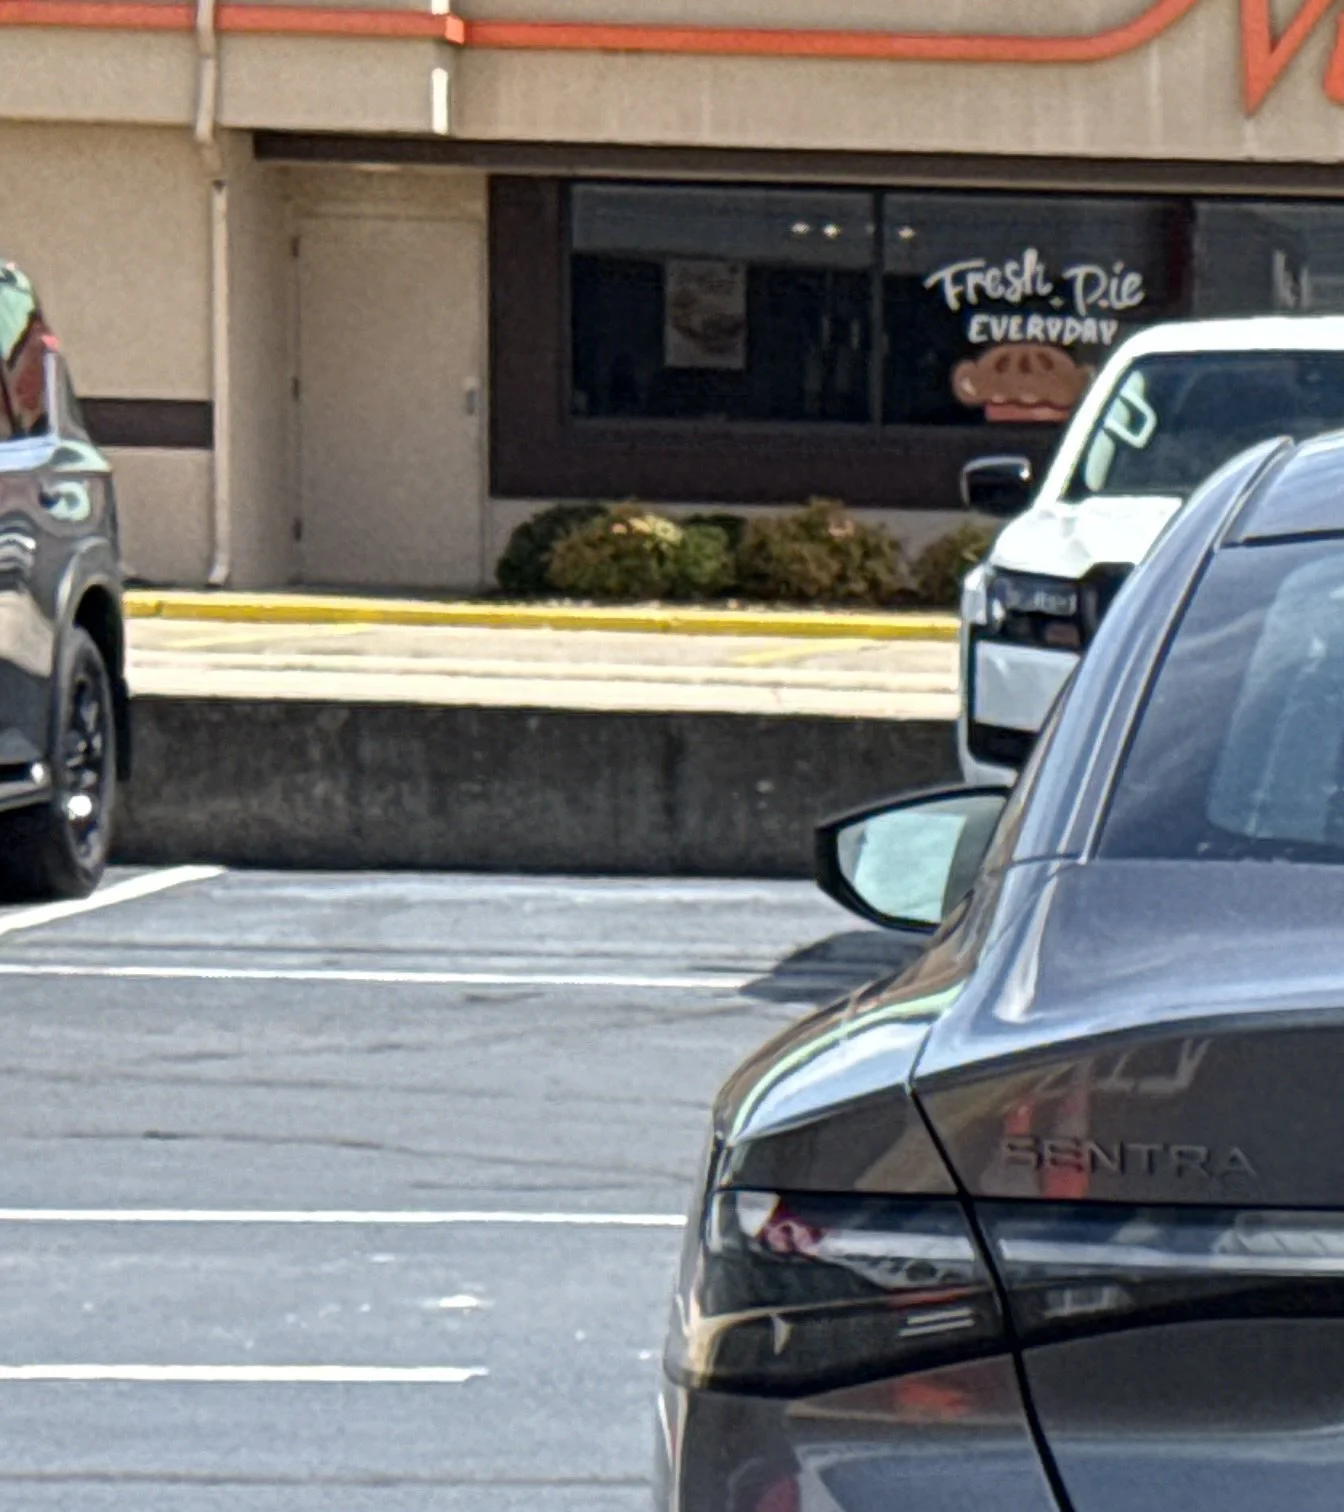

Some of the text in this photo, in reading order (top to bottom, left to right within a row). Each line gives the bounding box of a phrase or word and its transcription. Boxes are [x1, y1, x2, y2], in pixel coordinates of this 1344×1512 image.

[923, 248, 1145, 315] Fresh Pie
[967, 313, 1118, 345] EVERYDAY
[1000, 1139, 1257, 1176] SENTRA
